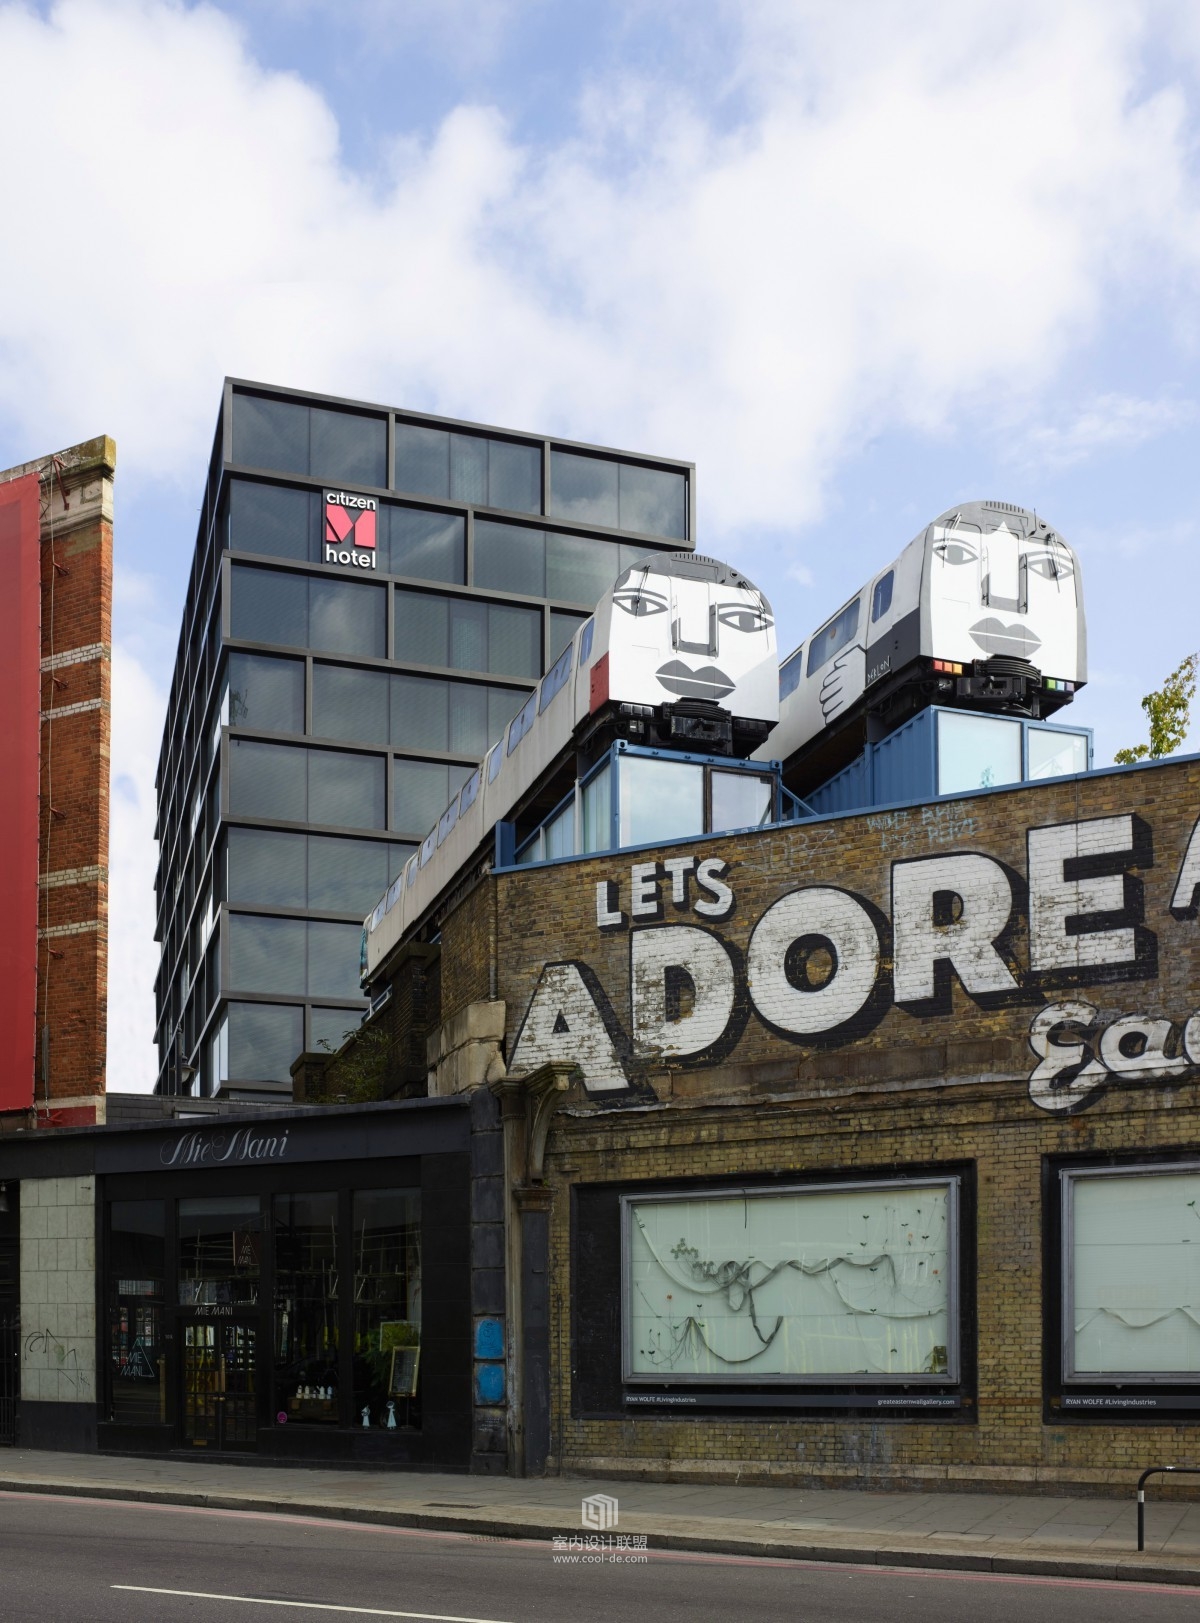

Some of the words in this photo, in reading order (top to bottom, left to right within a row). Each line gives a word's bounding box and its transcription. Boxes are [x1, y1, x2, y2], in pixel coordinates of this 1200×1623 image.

[326, 492, 376, 511] citizen
[326, 544, 376, 569] hotel
[596, 856, 737, 931] LETS
[505, 814, 1150, 1096] ADORE
[160, 1131, 212, 1165] Mie
[212, 1127, 290, 1161] Mani
[210, 1306, 233, 1316] MANI
[1104, 1399, 1157, 1407] #LivingIndustries
